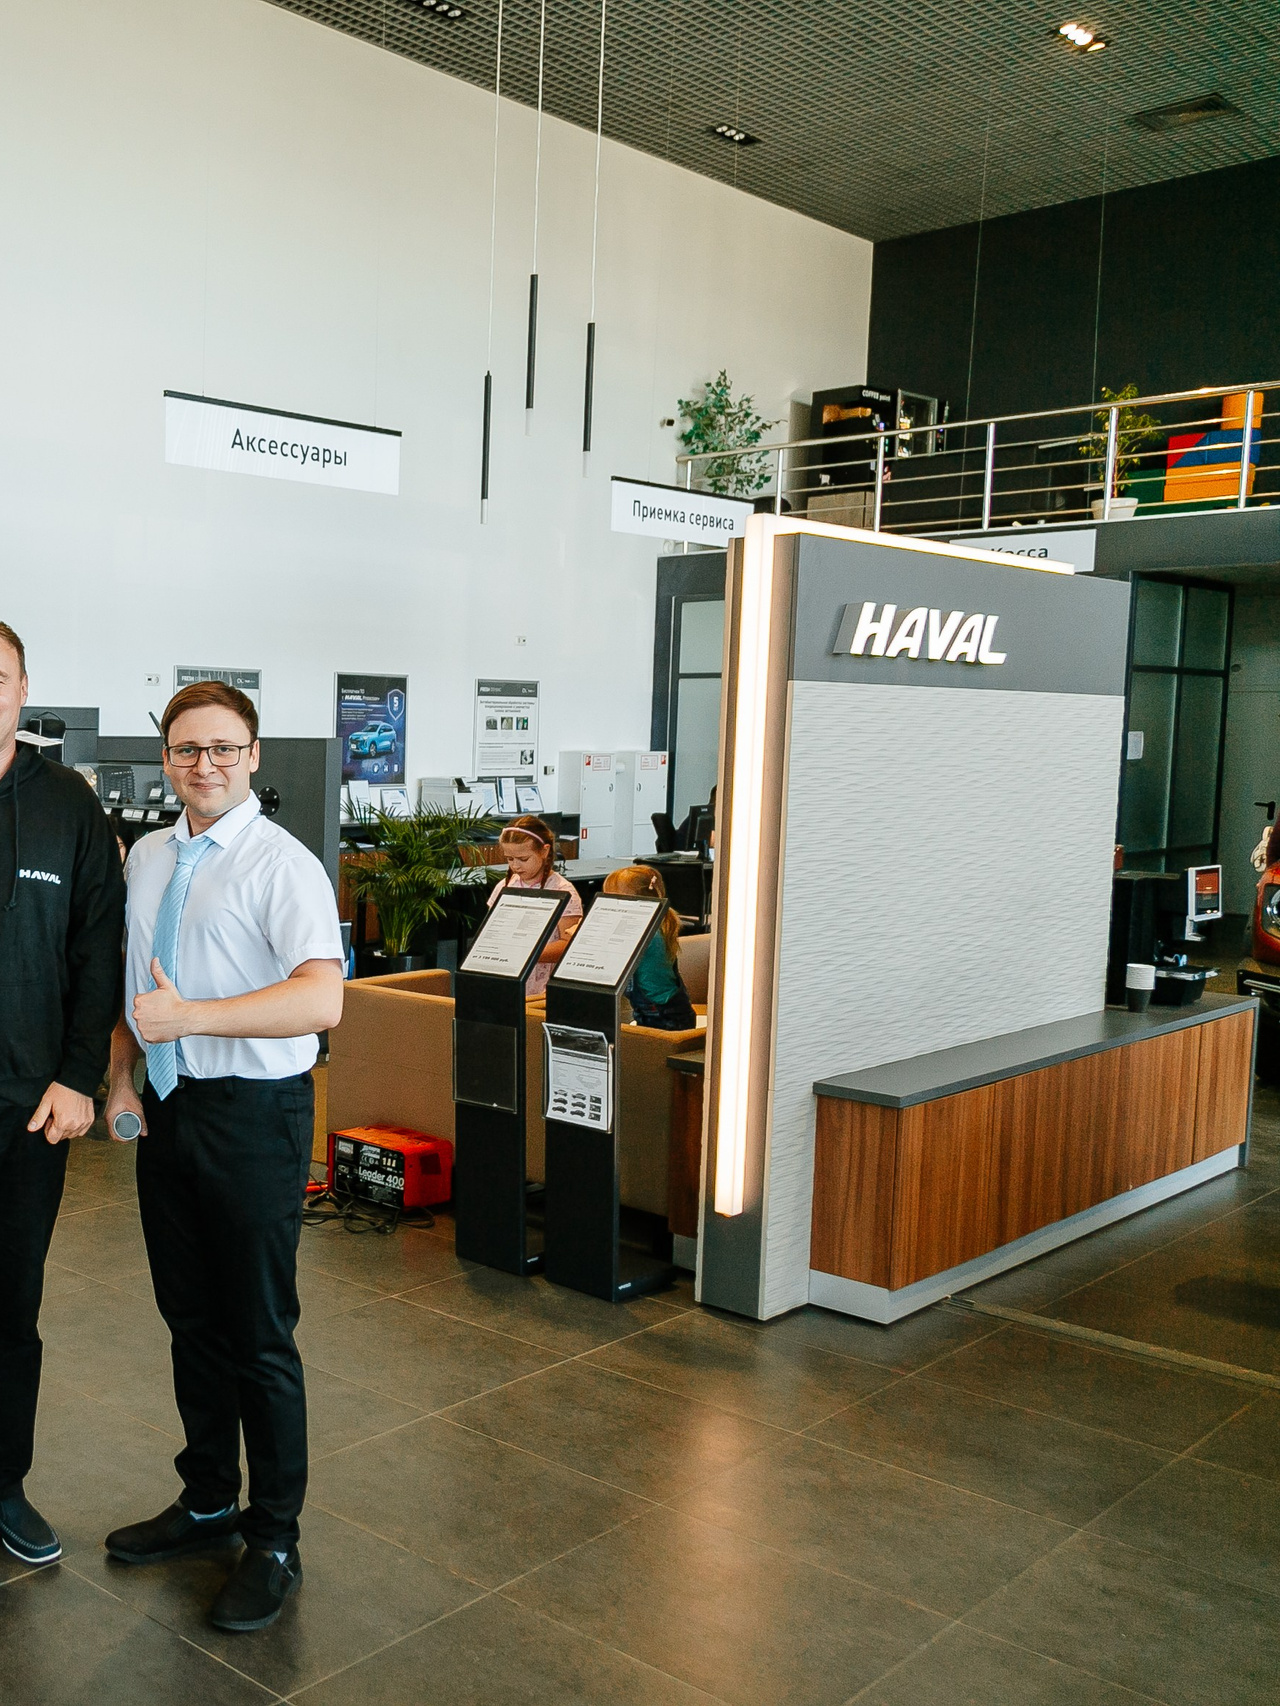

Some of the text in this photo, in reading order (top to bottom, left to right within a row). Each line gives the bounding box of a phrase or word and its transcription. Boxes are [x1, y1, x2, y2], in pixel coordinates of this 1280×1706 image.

[231, 428, 347, 468] Аксессуары
[632, 499, 734, 530] Приемка сервиса
[990, 546, 1048, 558] сса
[850, 601, 1007, 665] HAVAL
[393, 696, 399, 707] 5
[19, 869, 61, 885] HAVAL
[359, 1166, 385, 1181] Leader
[386, 1174, 404, 1187] 400
